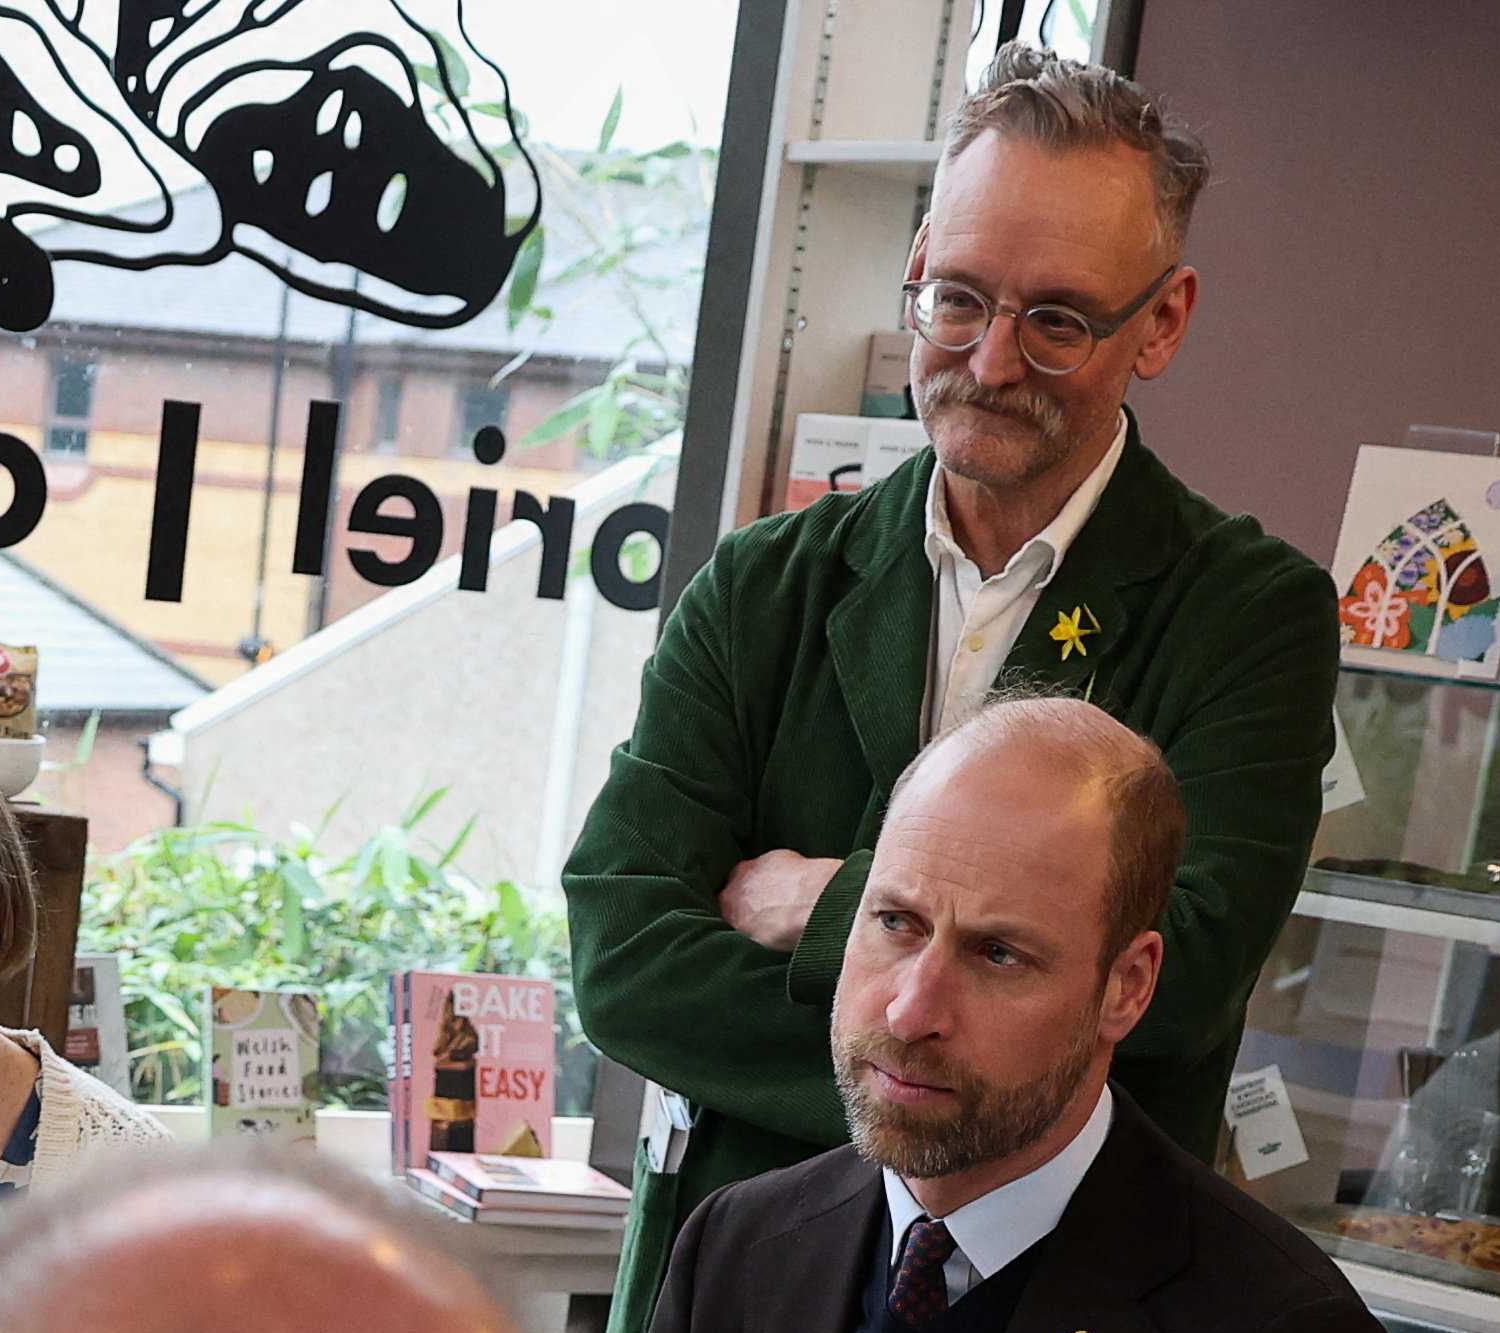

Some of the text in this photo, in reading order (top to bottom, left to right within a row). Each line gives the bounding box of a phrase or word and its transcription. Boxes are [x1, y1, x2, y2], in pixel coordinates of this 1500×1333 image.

[453, 982, 546, 1021] BAKE
[237, 1036, 294, 1056] Welsh
[478, 1024, 506, 1058] IT
[243, 1059, 288, 1078] Food
[238, 1083, 300, 1104] Stories
[479, 1067, 546, 1101] EASY
